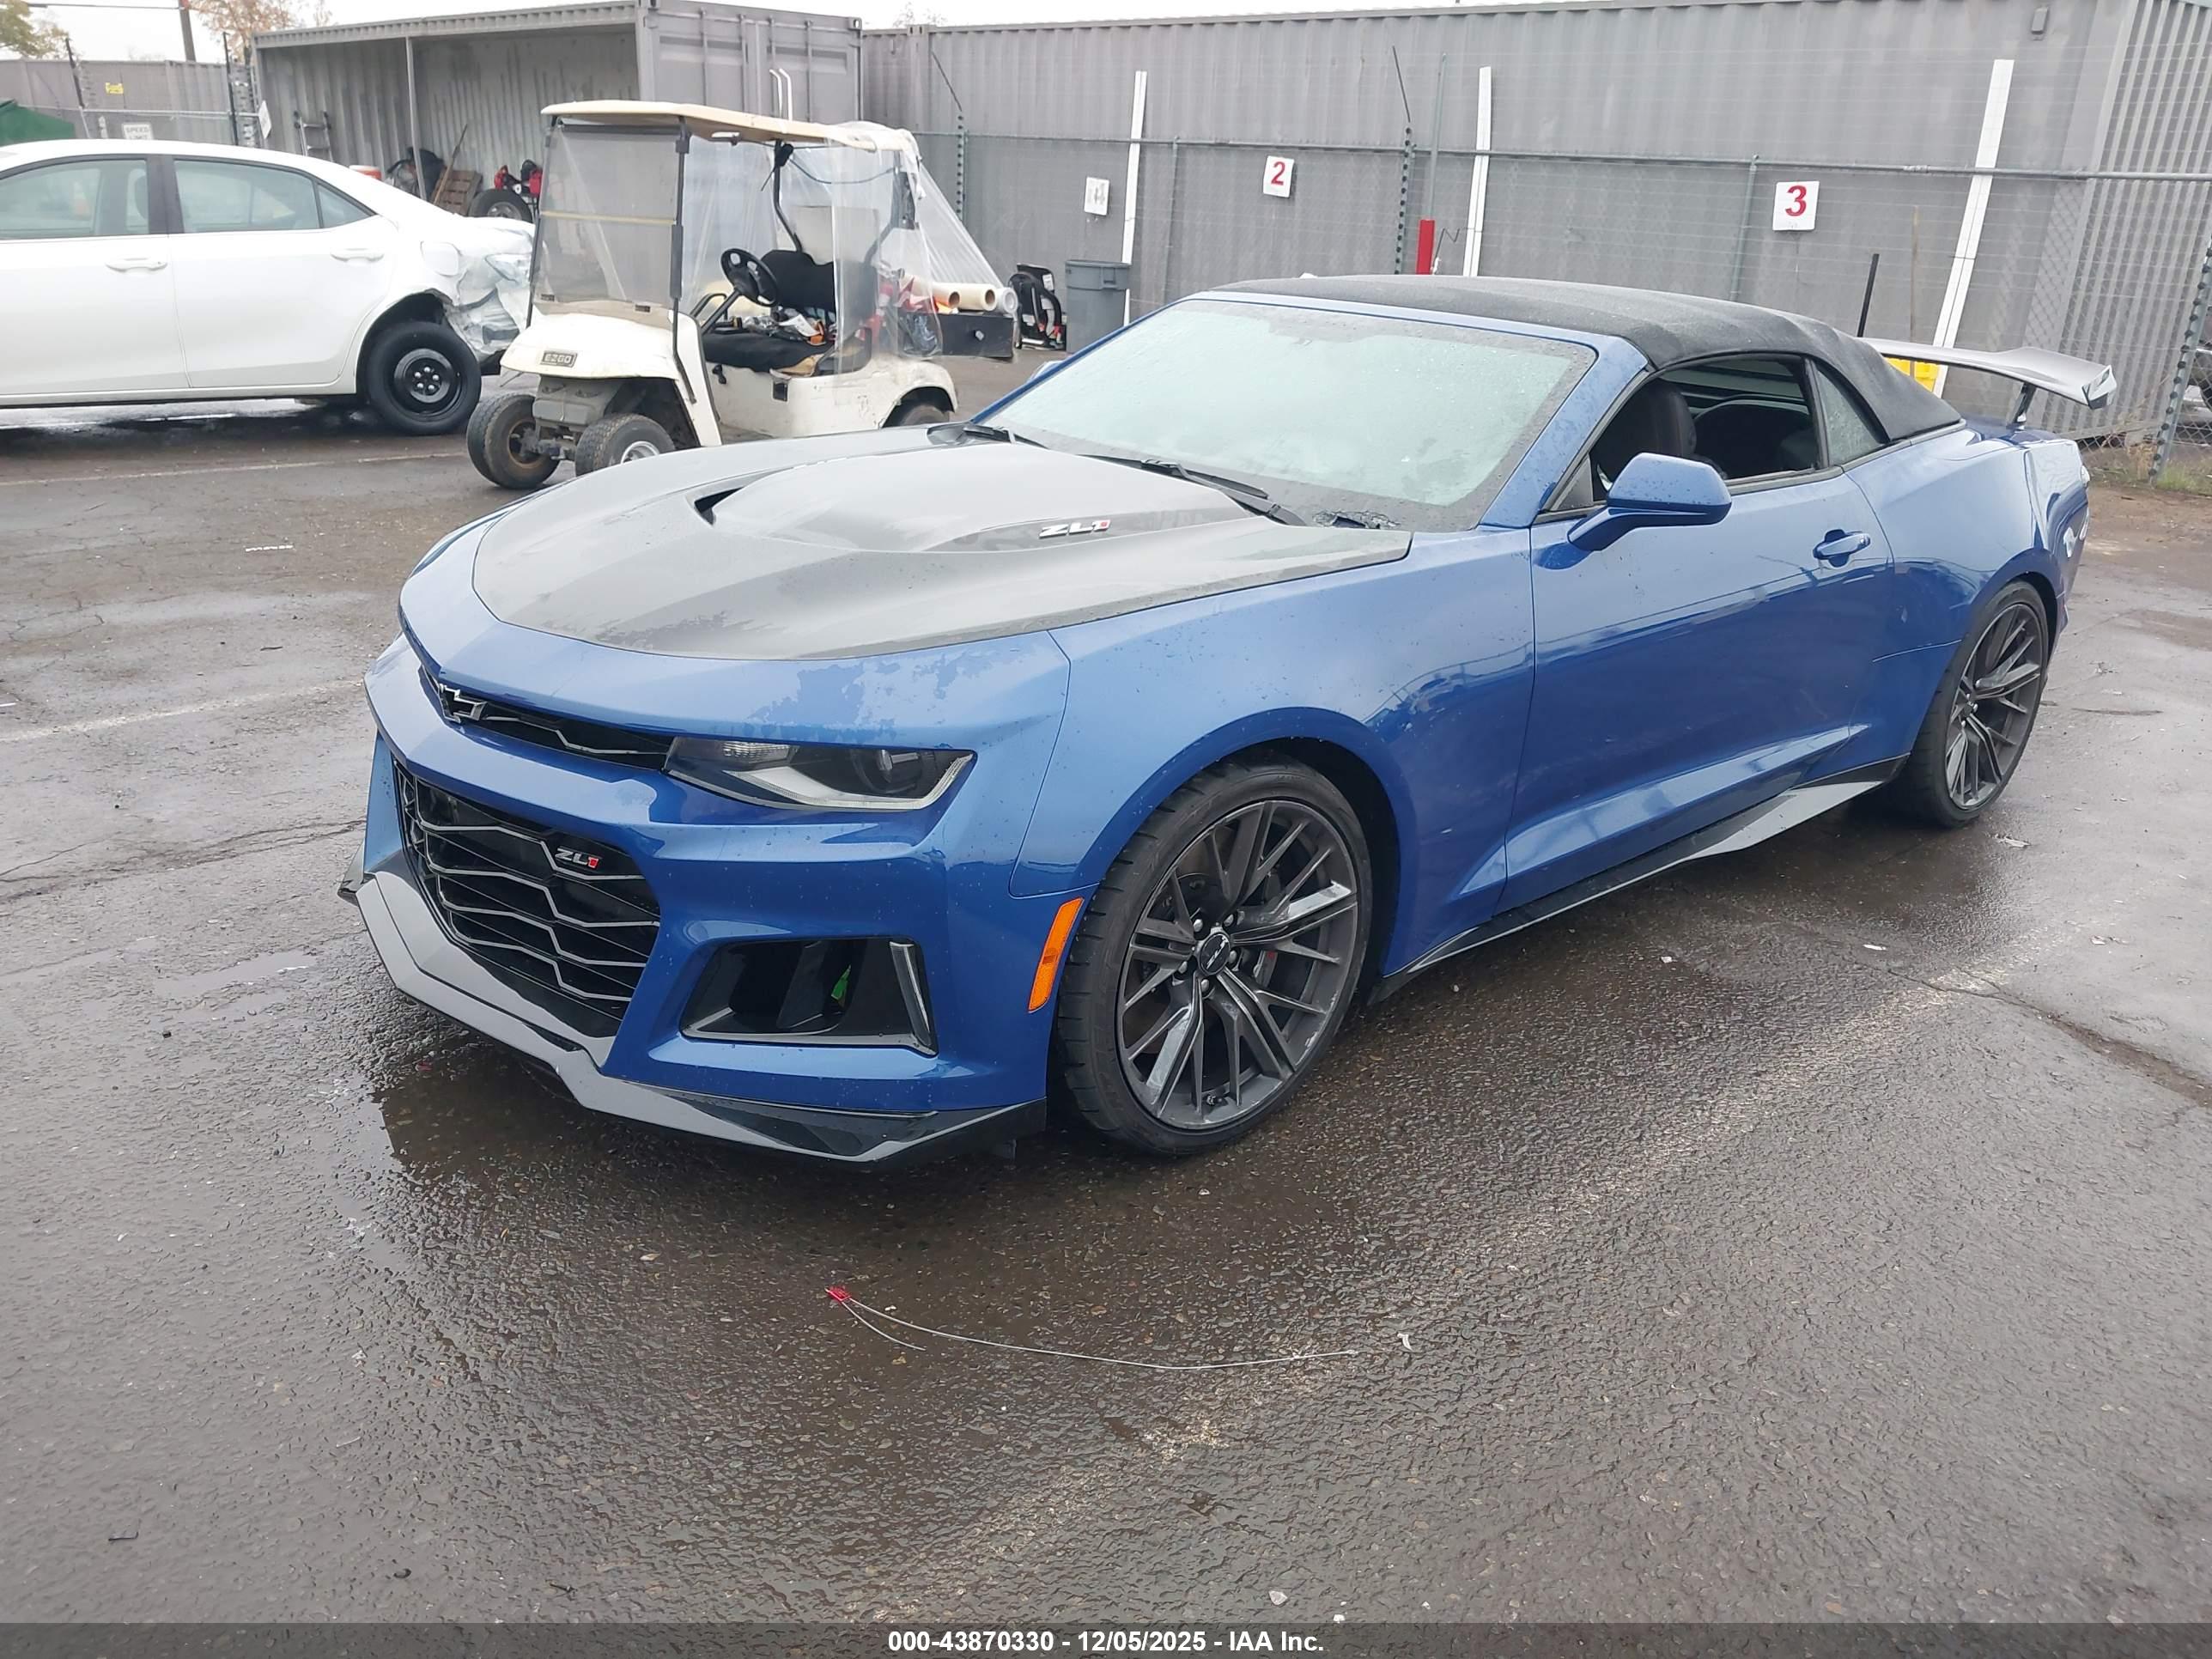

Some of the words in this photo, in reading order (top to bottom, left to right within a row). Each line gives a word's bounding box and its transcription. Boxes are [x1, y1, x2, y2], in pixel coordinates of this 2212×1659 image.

[1271, 161, 1285, 185] 2
[1785, 185, 1808, 216] 3
[1038, 520, 1111, 539] ZL1
[555, 847, 600, 869] ZL1
